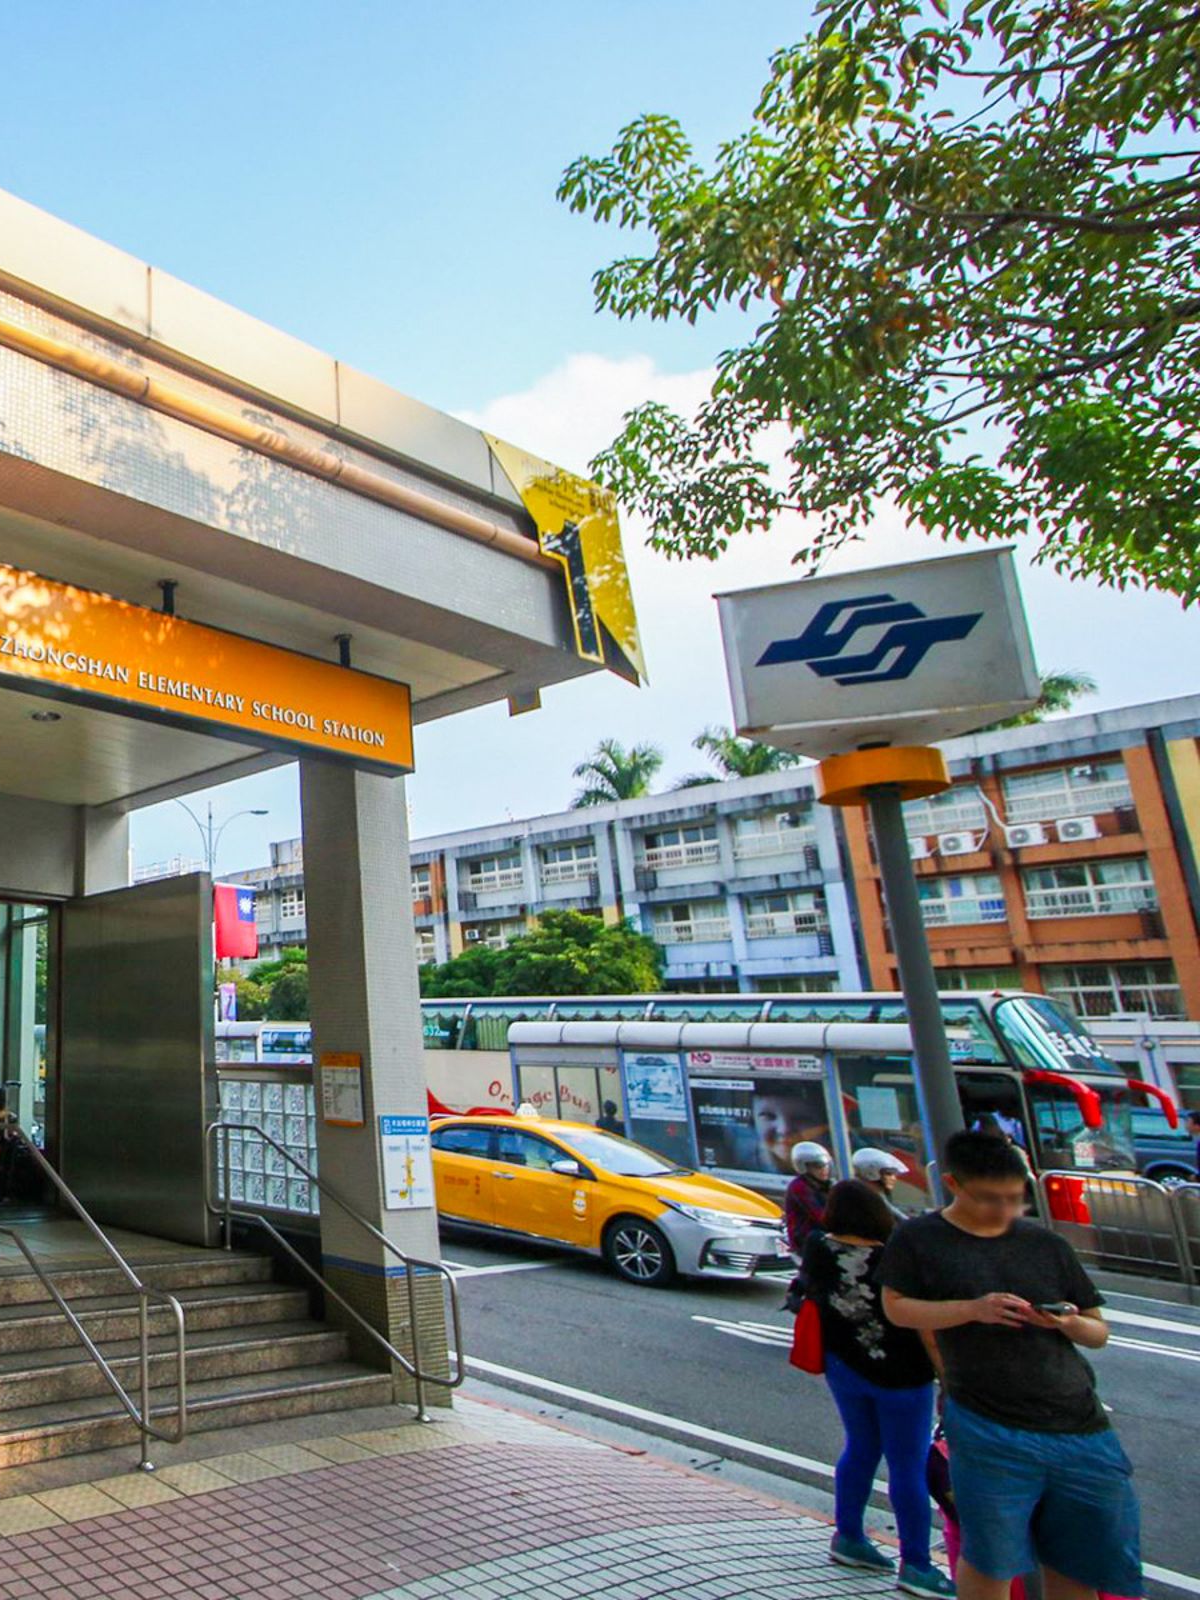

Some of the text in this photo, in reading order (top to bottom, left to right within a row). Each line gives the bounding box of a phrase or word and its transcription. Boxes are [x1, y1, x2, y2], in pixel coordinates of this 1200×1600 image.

[0, 635, 385, 748] ZHONGSHAN ELEMENTARY SCHOOL STATION
